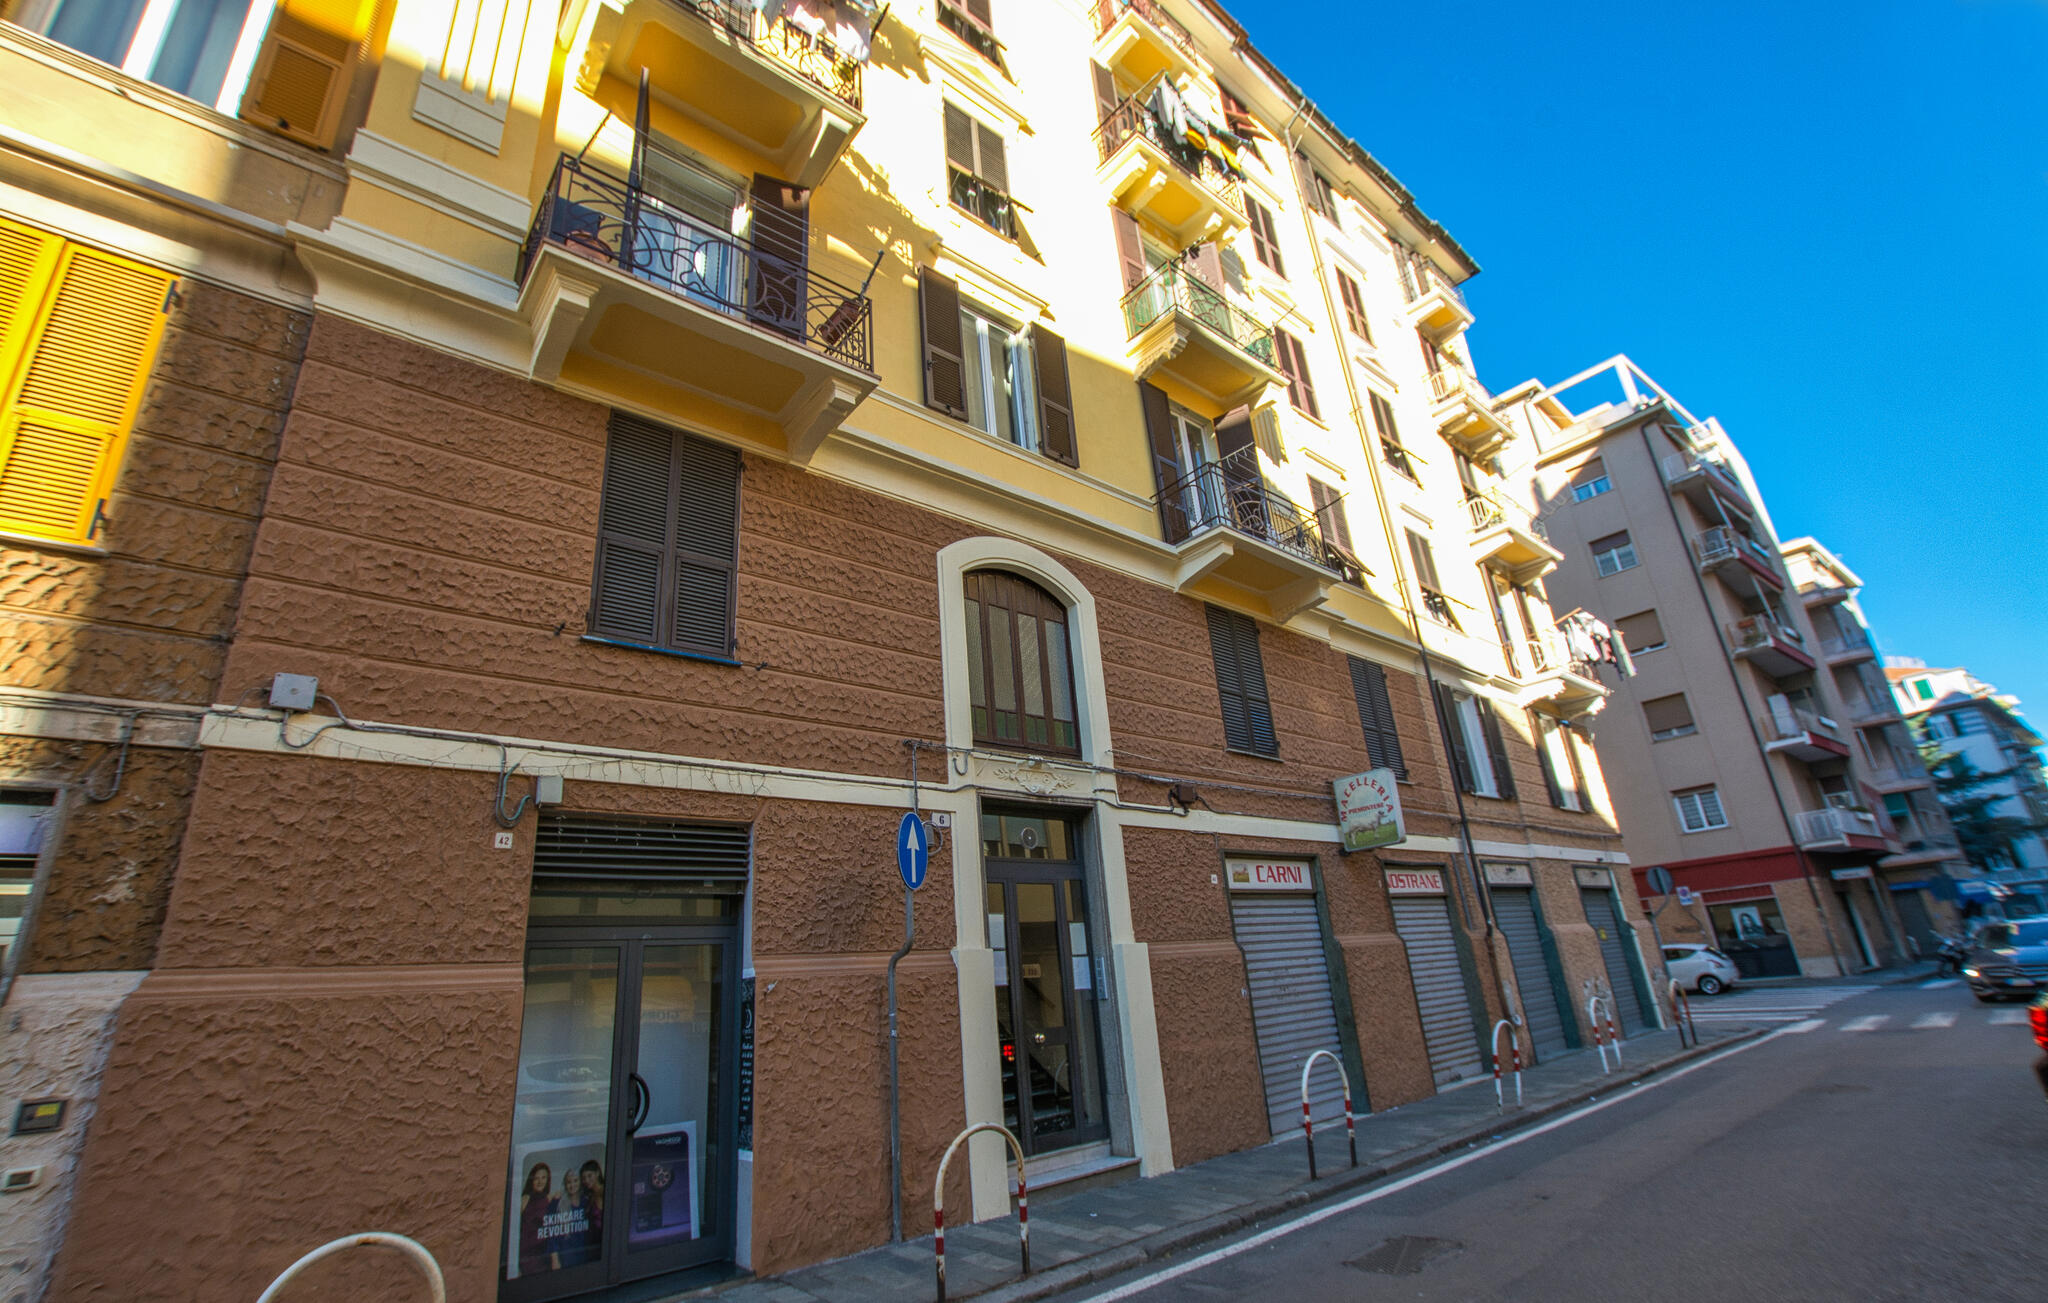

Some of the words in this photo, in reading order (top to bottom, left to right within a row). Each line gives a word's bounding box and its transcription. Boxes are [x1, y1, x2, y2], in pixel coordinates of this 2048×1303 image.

[1340, 776, 1394, 822] MACELLERIA
[939, 814, 945, 825] 6
[498, 835, 510, 846] 42
[1255, 864, 1303, 884] CARNI
[542, 1209, 585, 1226] SKINCARE
[537, 1218, 589, 1240] REVOLUTION
